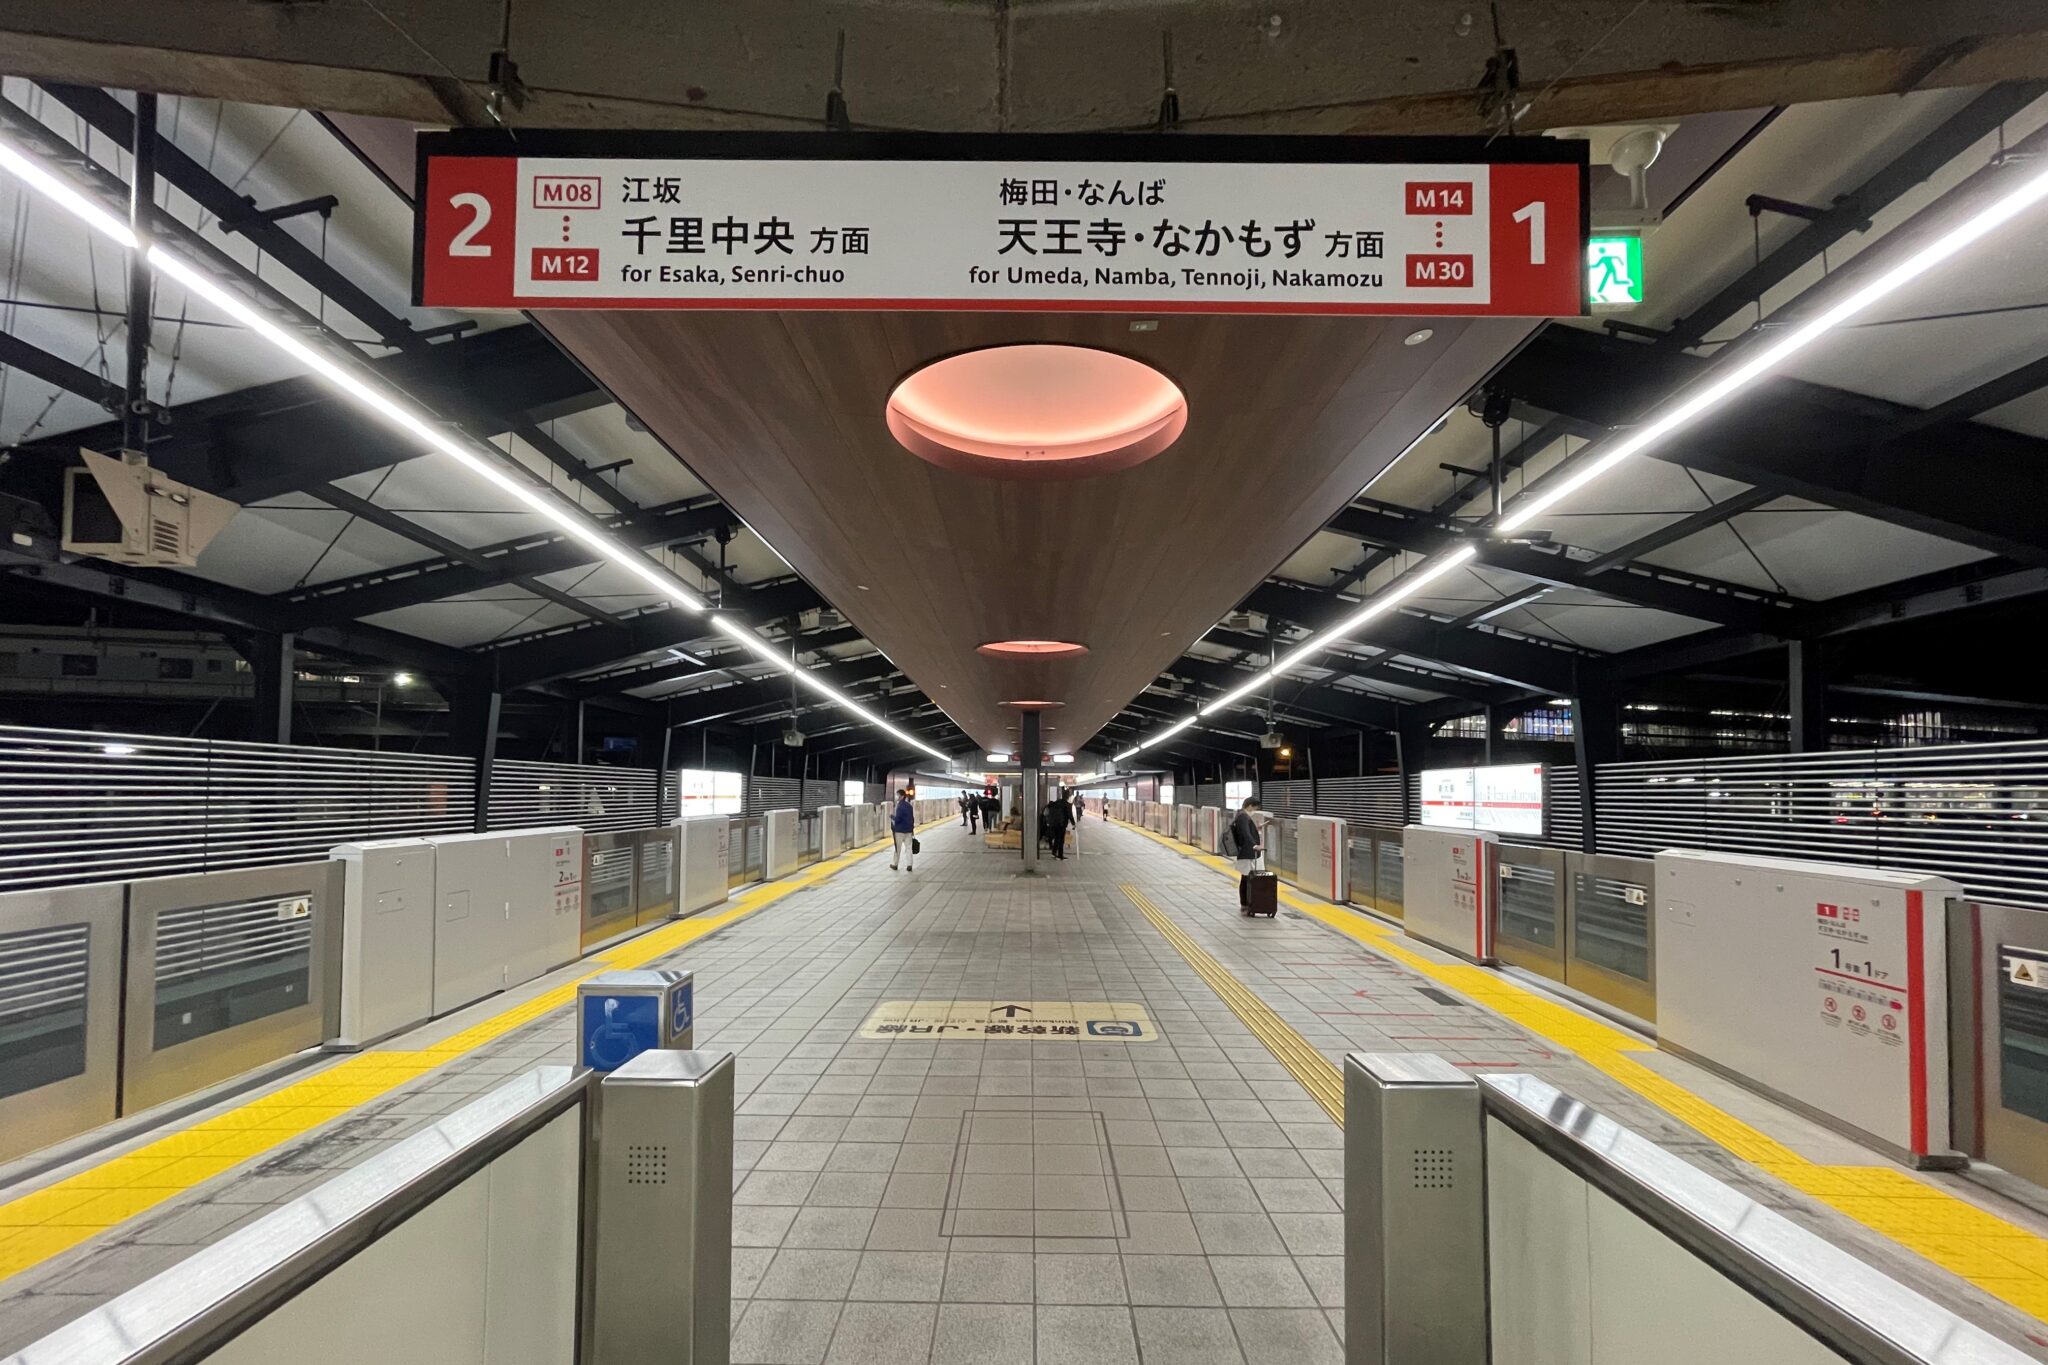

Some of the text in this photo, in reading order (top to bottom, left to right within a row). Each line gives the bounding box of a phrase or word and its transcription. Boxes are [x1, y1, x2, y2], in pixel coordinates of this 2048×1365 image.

[544, 184, 591, 201] M08
[623, 177, 681, 203] 江坂
[1416, 190, 1463, 207] M14
[449, 193, 491, 256] 2
[622, 216, 869, 255] 千里中央 方面
[1513, 202, 1545, 264] 1
[1325, 231, 1383, 258] 方面
[543, 256, 588, 273] M12
[621, 265, 844, 285] for Esaka, Senri-chuo
[1416, 262, 1464, 279] M30
[969, 266, 1382, 290] for Umeda, Namba, Tennoji, Nakamozu
